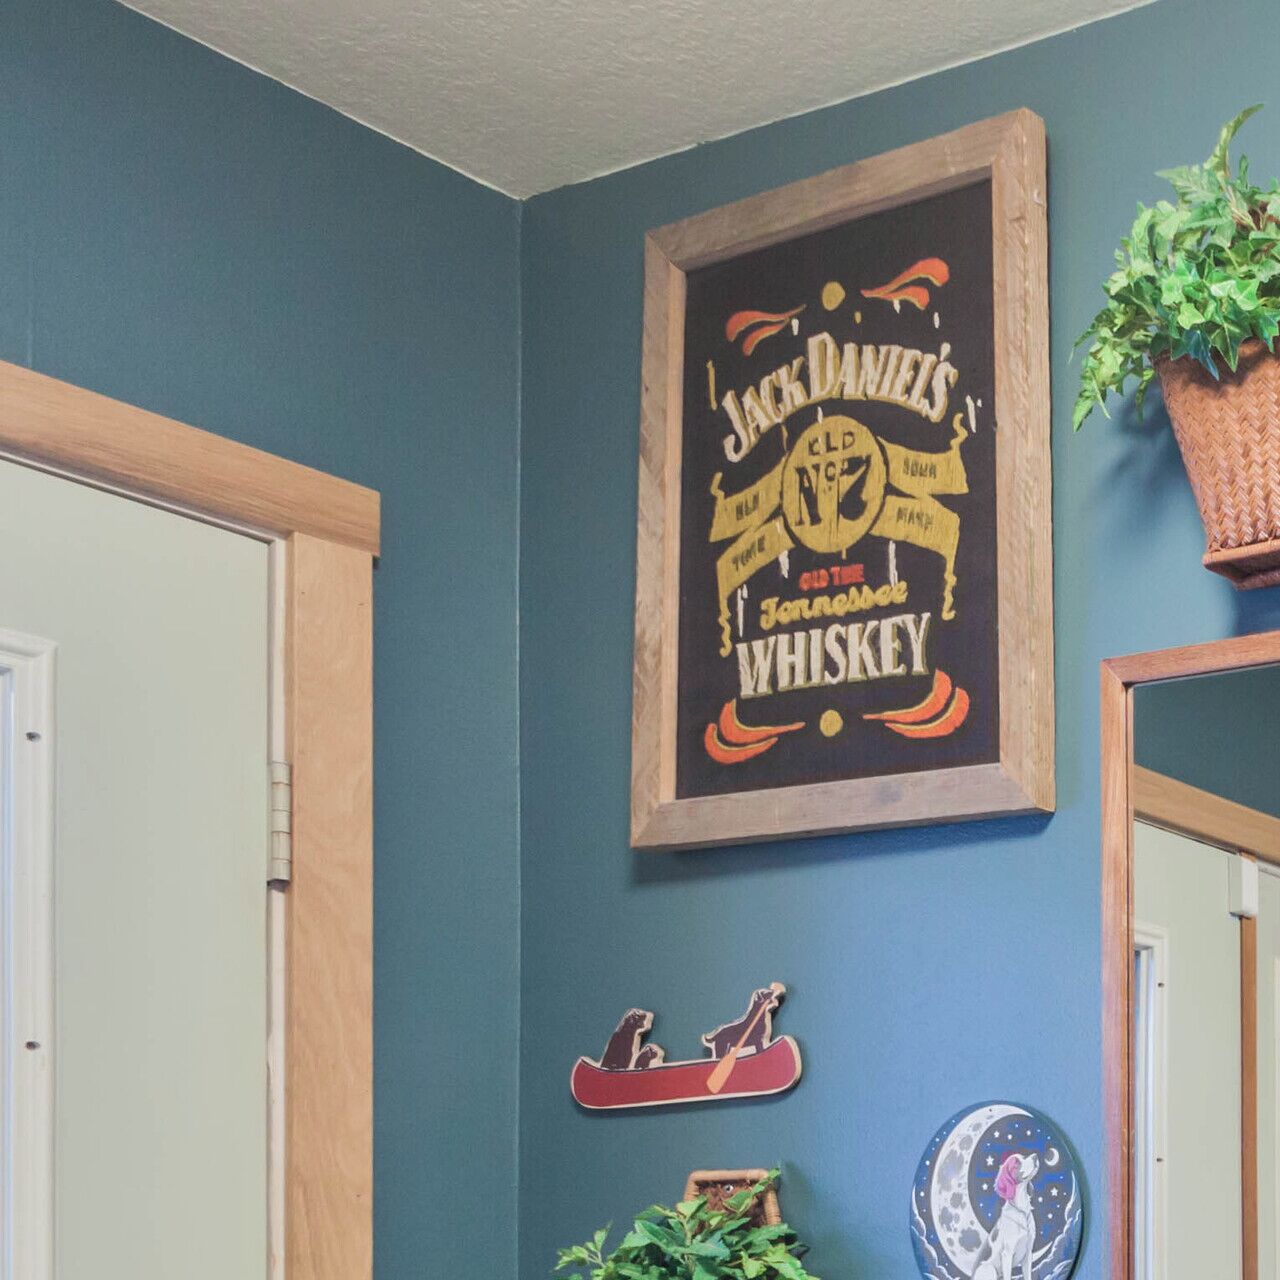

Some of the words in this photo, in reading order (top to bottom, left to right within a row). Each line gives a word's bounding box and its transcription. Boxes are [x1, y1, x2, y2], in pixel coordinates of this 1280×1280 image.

[722, 355, 809, 463] JACK
[807, 331, 959, 423] DANIEL'S
[760, 580, 909, 631] Tennessee
[735, 611, 932, 698] WHISKEY
